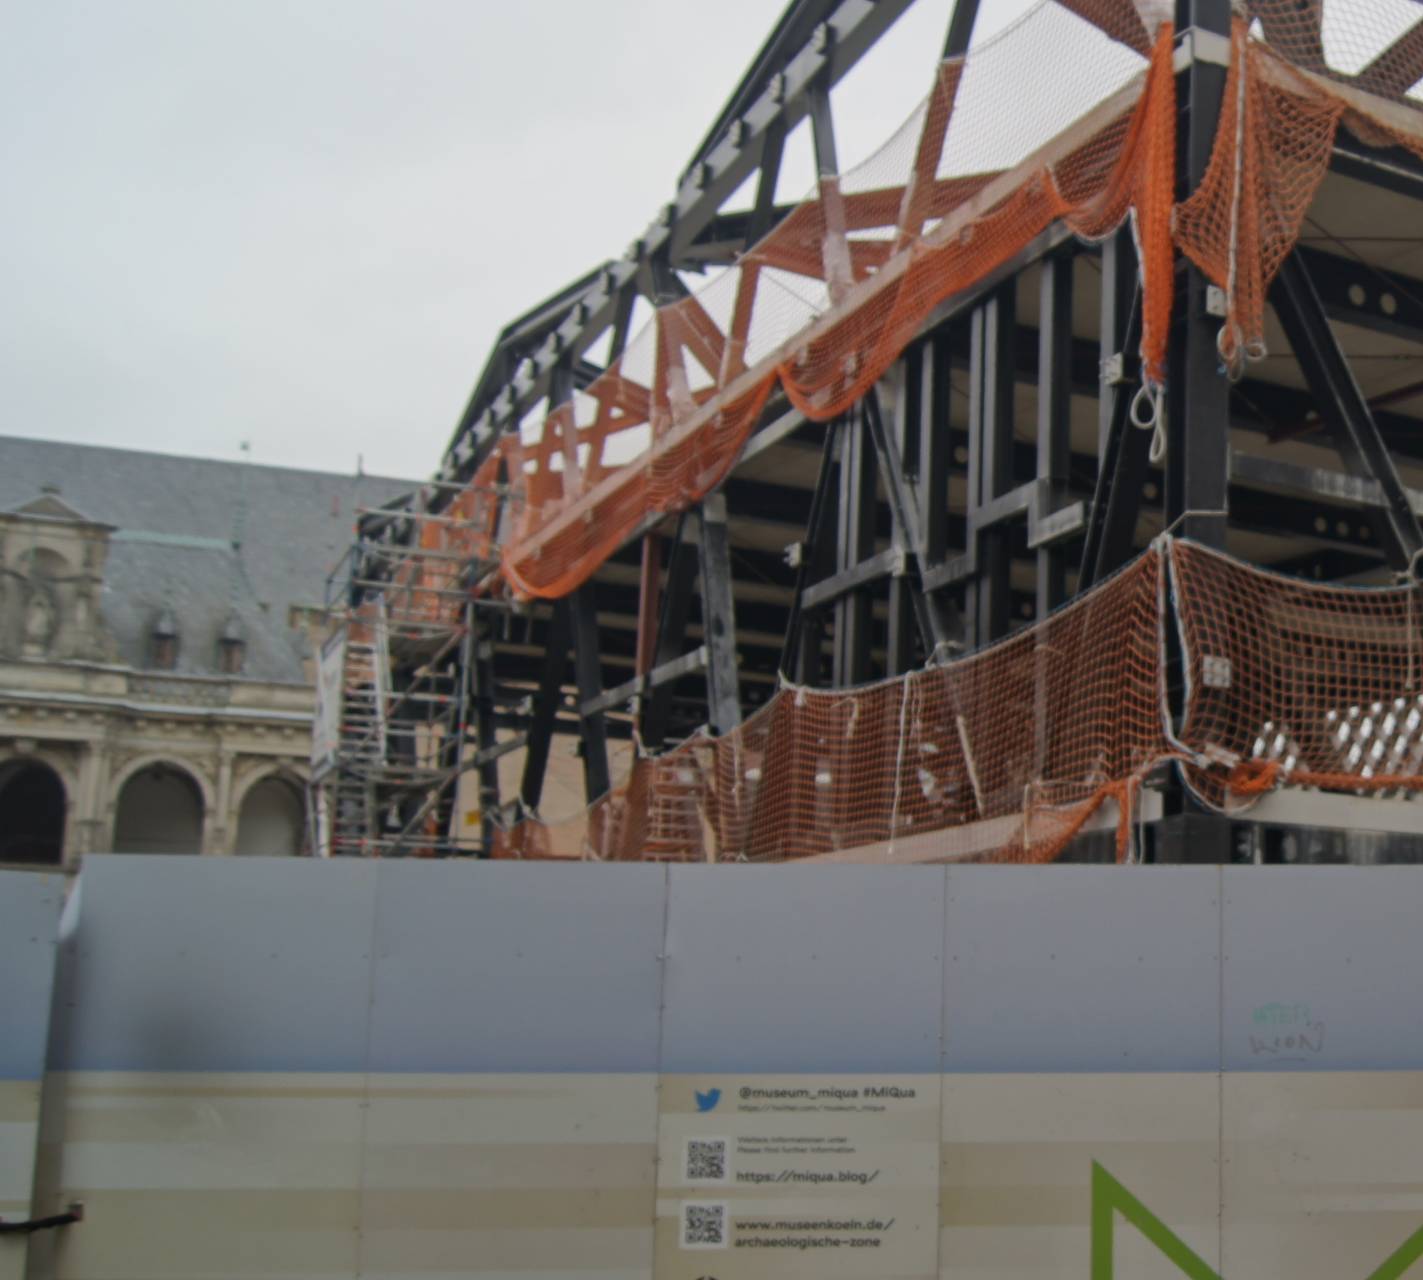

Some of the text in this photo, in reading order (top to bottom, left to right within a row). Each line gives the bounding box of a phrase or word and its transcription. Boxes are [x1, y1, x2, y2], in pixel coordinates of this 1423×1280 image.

[739, 1086, 916, 1100] @museum_miqua #MiQua
[736, 1170, 880, 1184] https://miqua.blog/
[735, 1218, 895, 1232] www.museenkoeln.de/
[734, 1236, 881, 1249] archaeologische-zone
